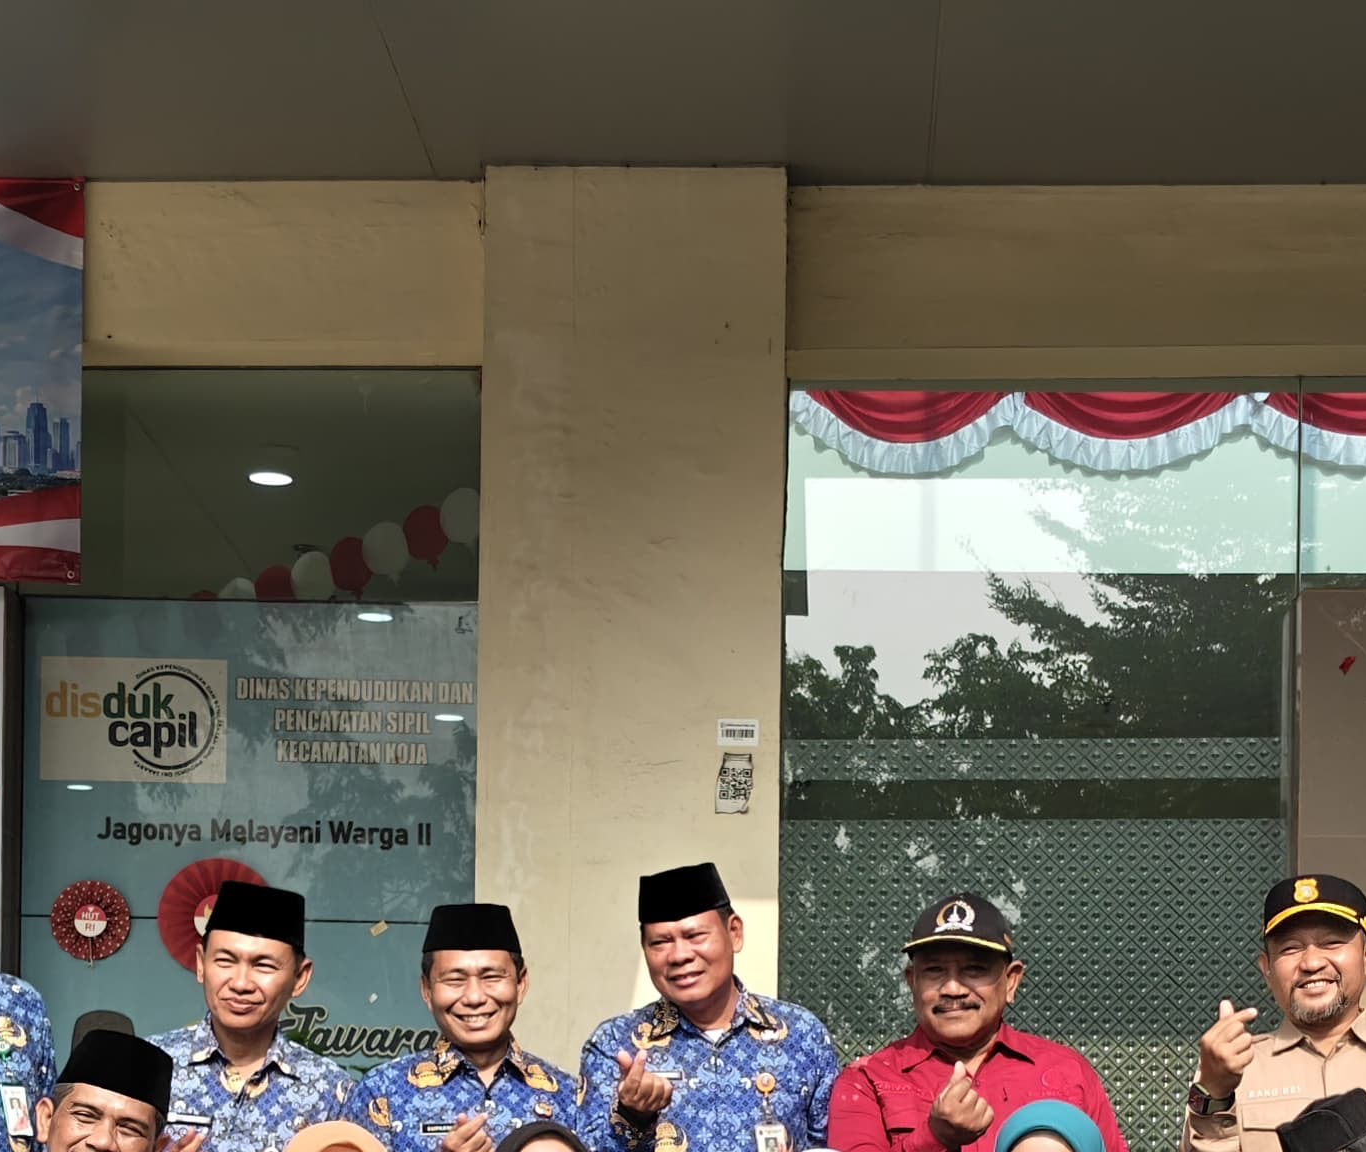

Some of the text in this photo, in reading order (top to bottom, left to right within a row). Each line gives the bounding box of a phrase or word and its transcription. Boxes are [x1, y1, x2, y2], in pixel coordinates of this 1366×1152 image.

[236, 677, 474, 704] DINAS KEPENDUDUKAN DAN
[274, 709, 432, 734] PENCATATAN SIPIL
[108, 711, 198, 758] capil
[276, 740, 428, 765] KECAMATAN KOJA
[97, 816, 201, 847] Jagonya
[210, 819, 322, 848] Melayani
[329, 821, 409, 850] Warga
[81, 911, 100, 920] HUT
[85, 923, 96, 931] RI
